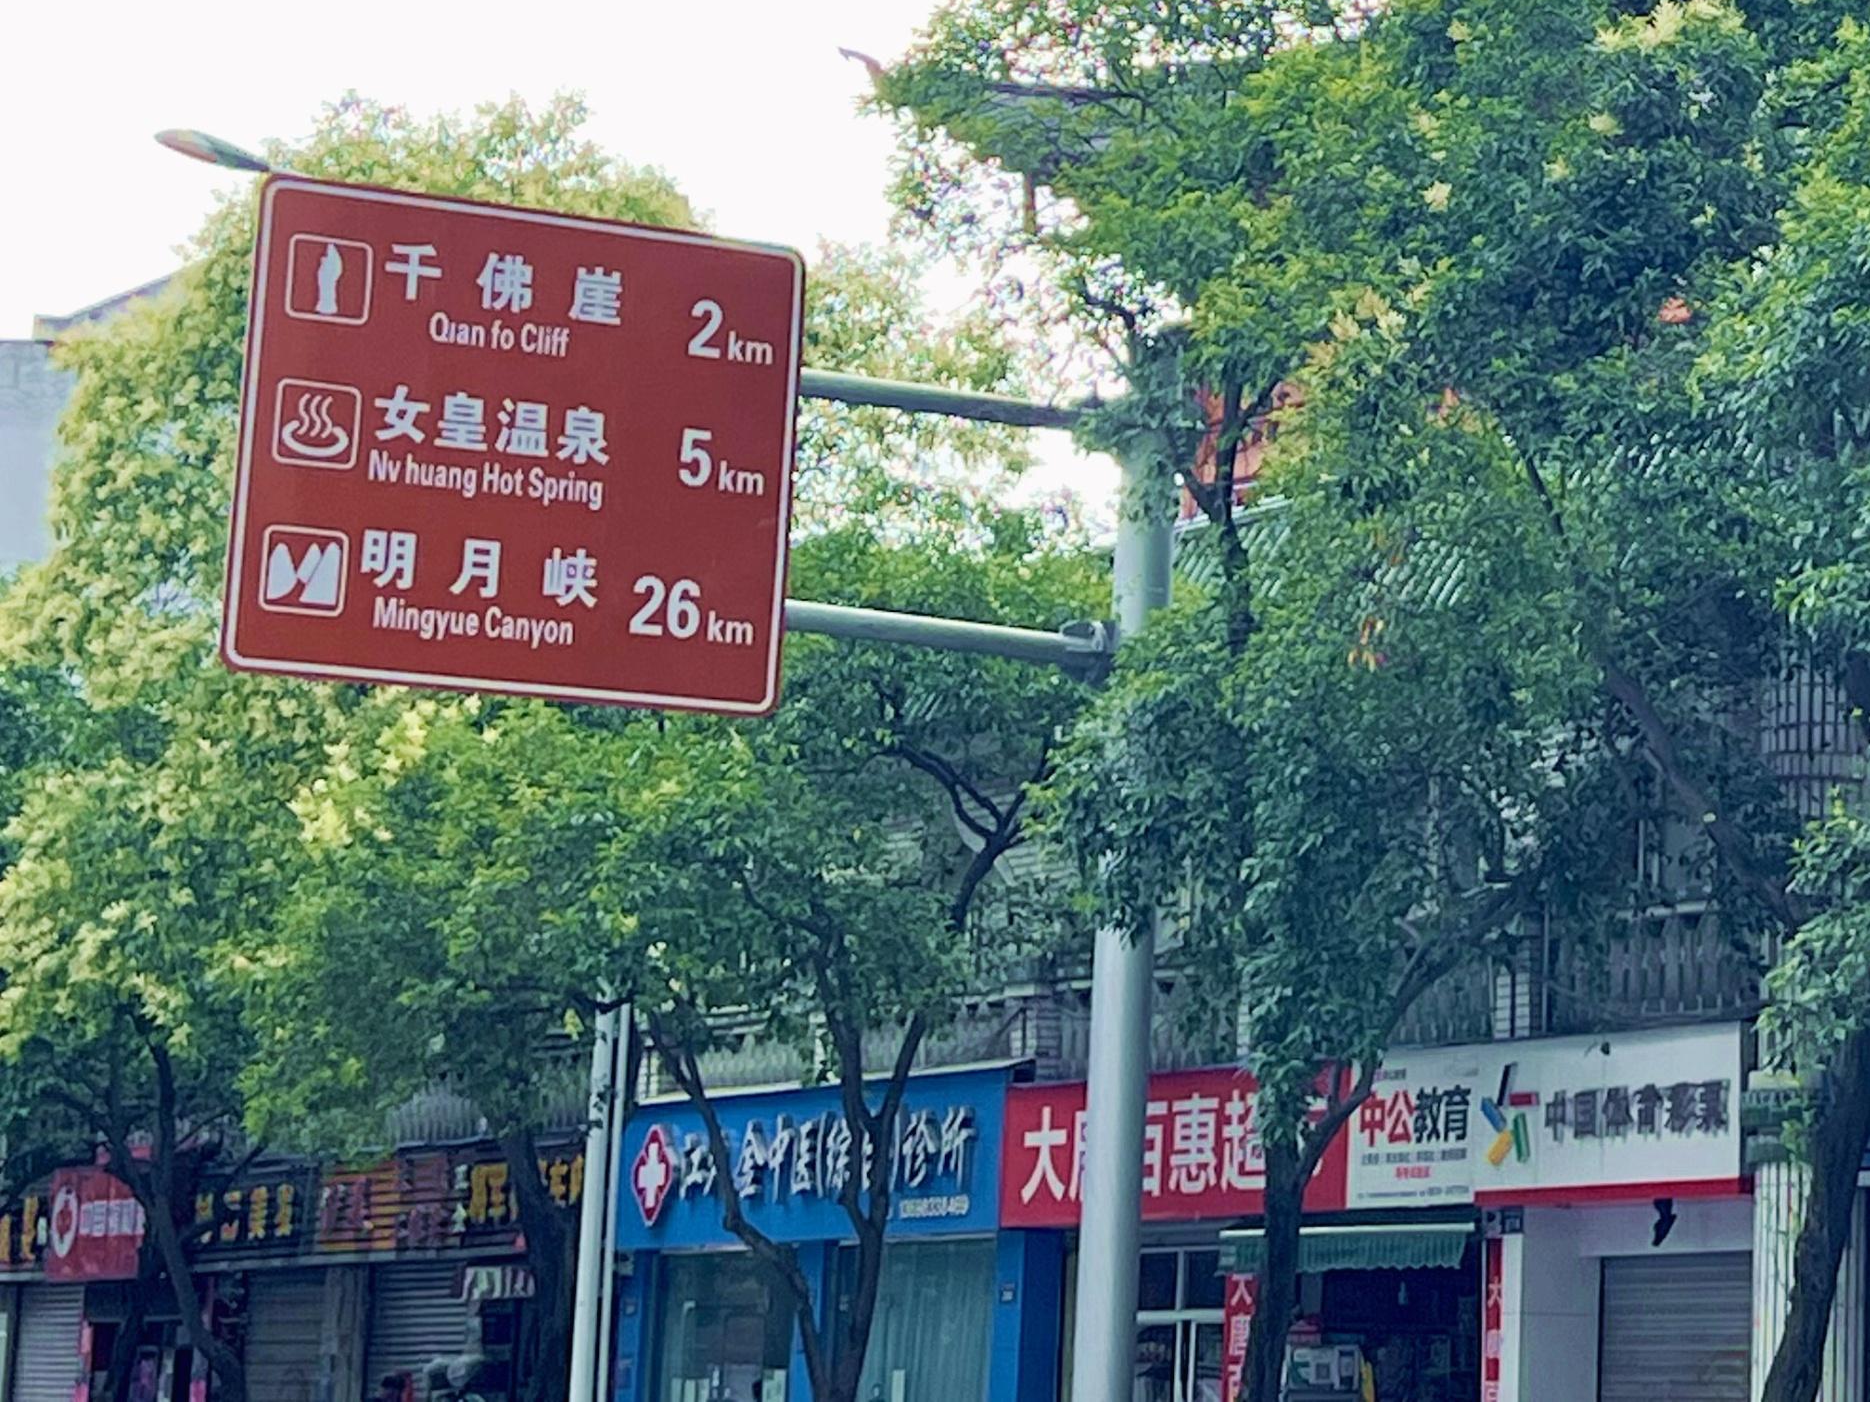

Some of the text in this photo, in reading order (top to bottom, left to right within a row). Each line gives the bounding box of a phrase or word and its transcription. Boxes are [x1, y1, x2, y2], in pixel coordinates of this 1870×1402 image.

[385, 243, 623, 326] 千佛崖
[429, 312, 570, 358] Qian fo Cliff
[374, 384, 610, 466] 女皇温泉
[482, 458, 524, 496] Hot
[527, 471, 604, 510] Spring
[360, 530, 598, 610] 明月峡
[372, 596, 575, 651] Mingyue Canyon
[1360, 1085, 1471, 1147] 中公教育
[1545, 1081, 1729, 1141] 中国体育彩票
[1020, 1089, 1327, 1204] 大百惠超
